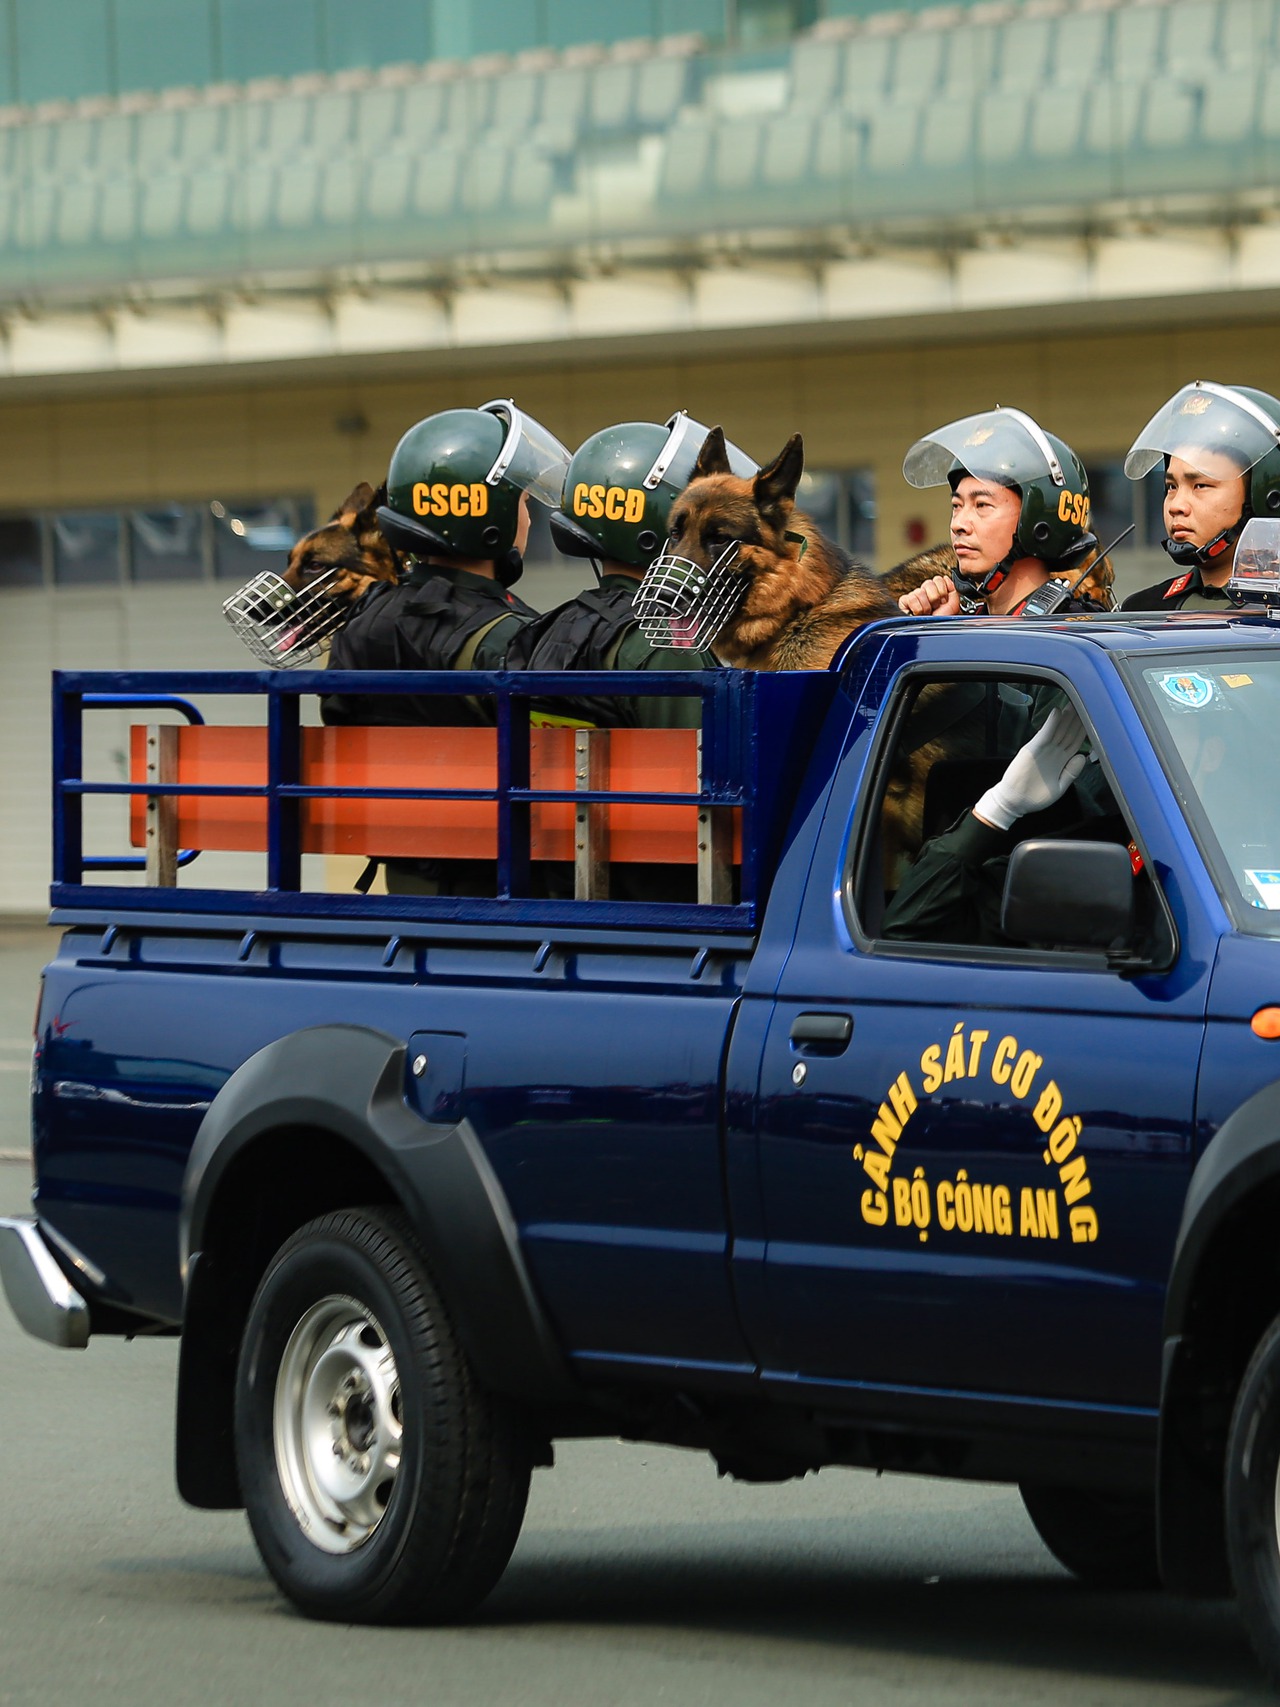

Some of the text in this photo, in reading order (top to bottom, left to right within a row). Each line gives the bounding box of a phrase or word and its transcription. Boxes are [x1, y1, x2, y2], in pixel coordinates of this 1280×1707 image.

[412, 482, 489, 517] CSCĐ
[573, 482, 646, 523] CSCĐ
[1058, 490, 1090, 528] CSC
[853, 1021, 1099, 1243] CẢNH SÁT CƠ ĐỘNG
[892, 1166, 1059, 1242] BỘ CÔNG AN
